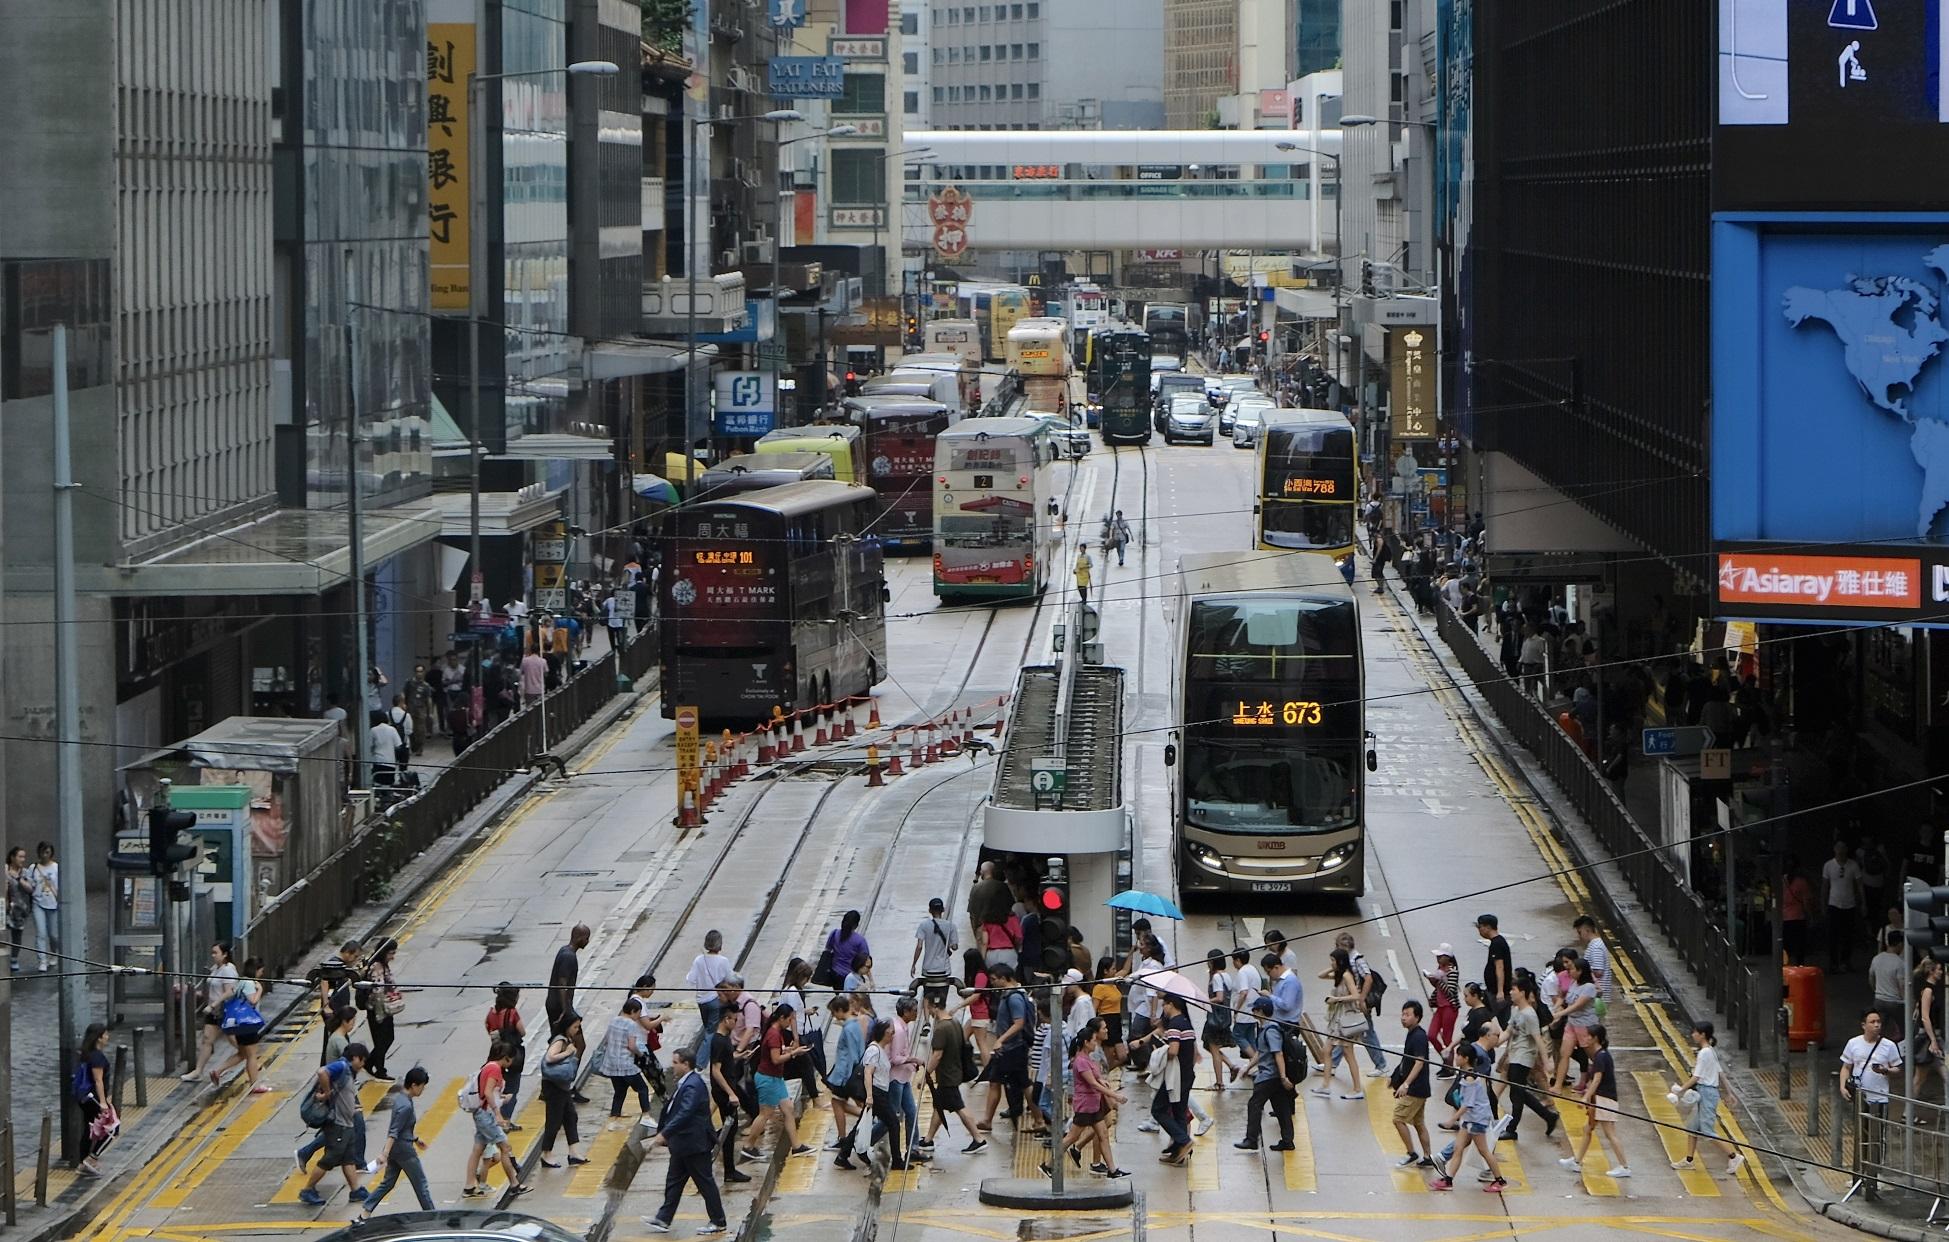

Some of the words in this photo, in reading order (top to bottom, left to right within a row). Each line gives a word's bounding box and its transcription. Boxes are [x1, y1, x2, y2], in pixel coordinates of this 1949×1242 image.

[772, 63, 801, 77] YAT
[812, 63, 839, 77] FAT
[769, 82, 843, 95] STATIONERS
[1155, 250, 1177, 258] KFC
[980, 476, 987, 487] 2
[1313, 483, 1335, 493] 788
[698, 522, 749, 539] 周大福
[740, 551, 753, 564] 101
[739, 586, 745, 594] T
[748, 586, 775, 594] MARK
[1741, 567, 1832, 600] Asiaray
[1836, 569, 1908, 597] 雅仕維
[1233, 701, 1274, 717] 上水
[1283, 701, 1321, 724] 673
[1703, 752, 1728, 768] FT
[1256, 883, 1265, 891] TE
